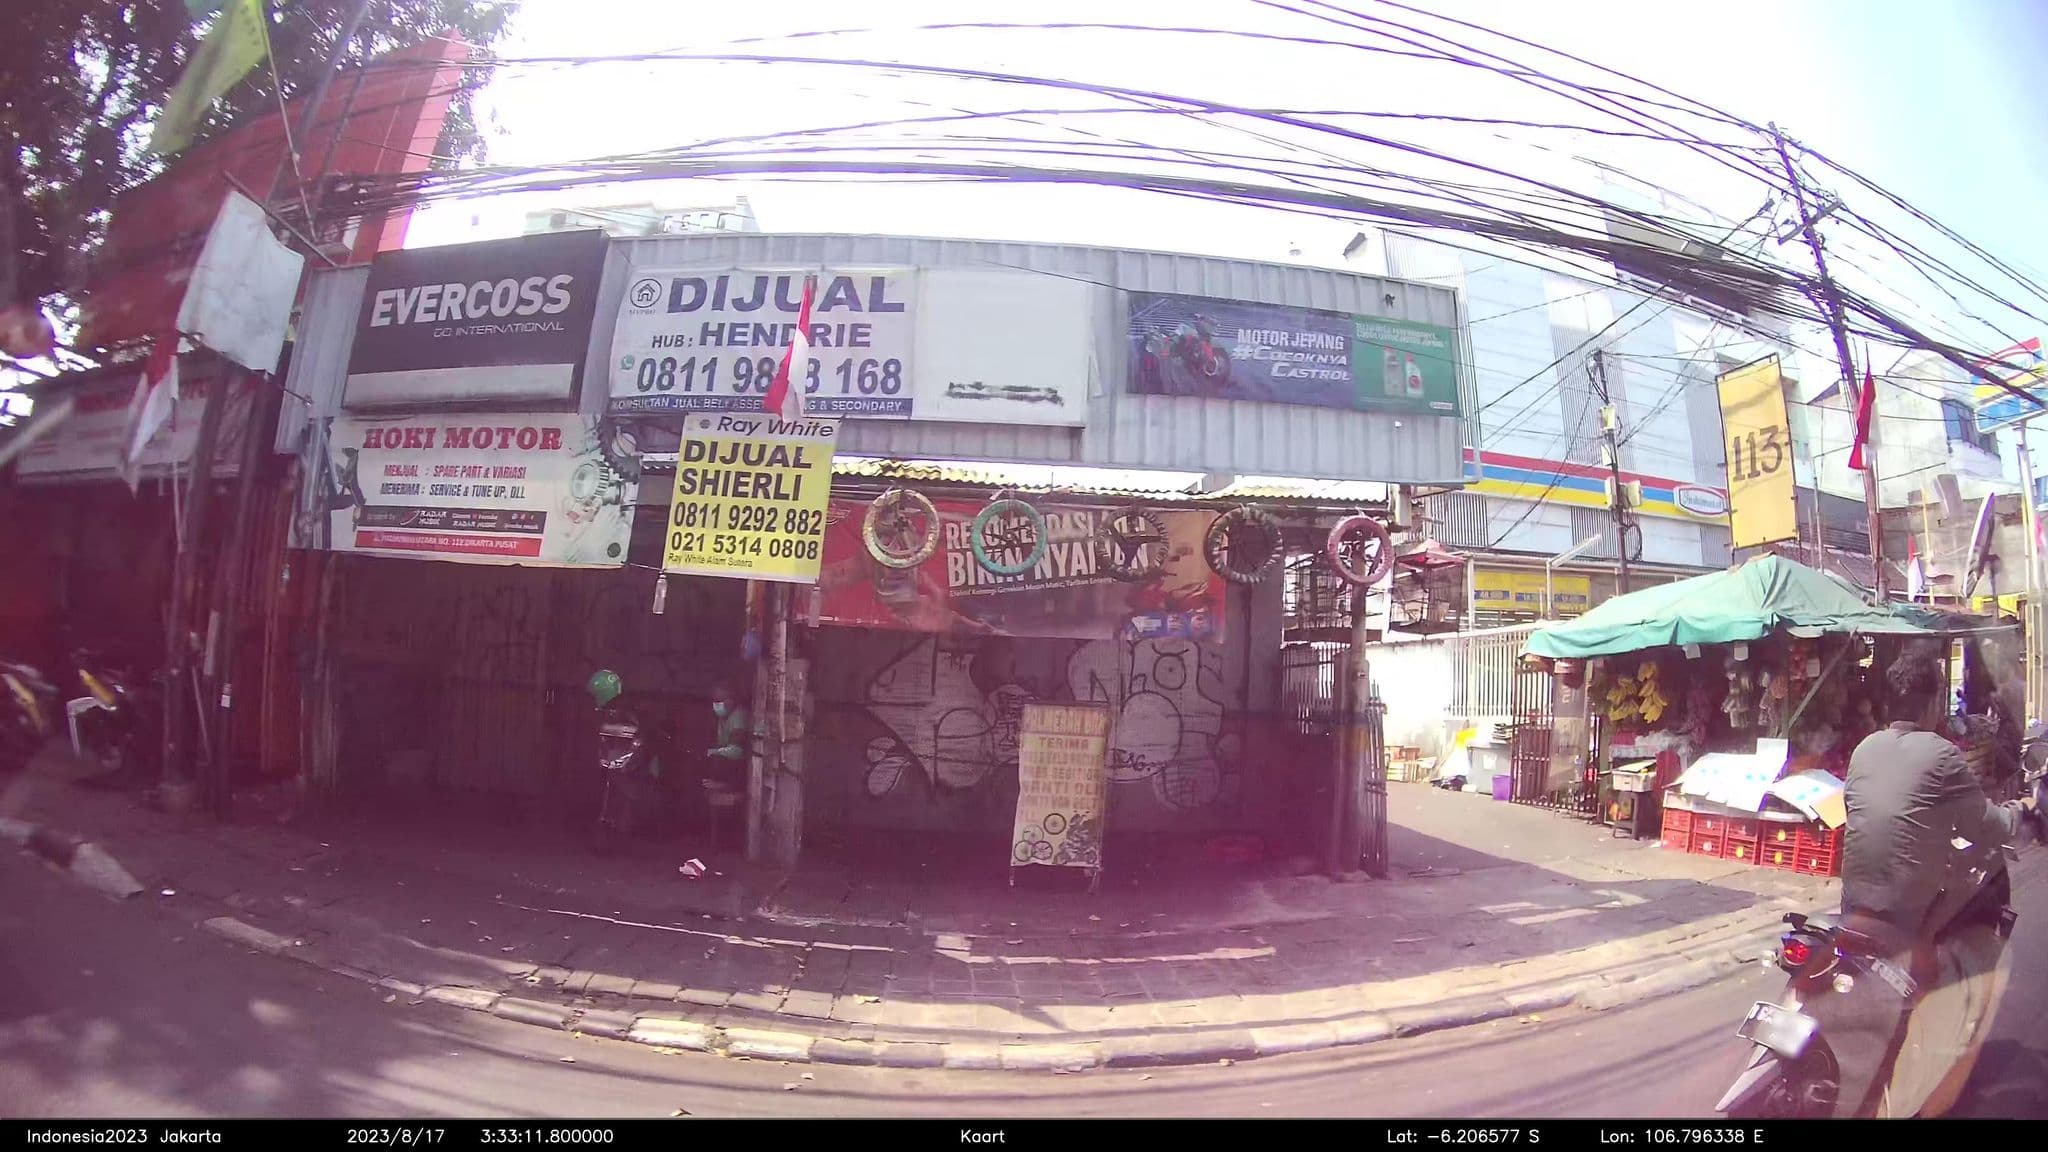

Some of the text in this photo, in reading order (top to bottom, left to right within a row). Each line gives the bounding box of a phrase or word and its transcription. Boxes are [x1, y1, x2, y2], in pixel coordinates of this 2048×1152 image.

[370, 274, 574, 328] EVERCOSS
[667, 275, 905, 314] DIJUAL
[456, 321, 564, 336] INTERNATIONAL
[1237, 328, 1289, 347] MOTOR
[1291, 332, 1345, 350] JEPANG
[636, 356, 719, 393] 0811
[836, 358, 902, 395] 168
[672, 398, 700, 409] JUAL
[832, 400, 902, 411] SECONDARY
[362, 427, 564, 450] HOKI MOTOR
[716, 416, 834, 438] Ray White
[683, 439, 812, 469] DIJUAL
[1730, 426, 1784, 483] 113
[433, 464, 458, 478] SPARE
[460, 466, 482, 478] PART
[492, 466, 526, 480] VARIASI
[679, 468, 803, 502] SHIERLI
[429, 484, 462, 496] SERVICE
[471, 485, 493, 498] TUNE
[510, 486, 526, 499] DLL
[674, 501, 722, 529] 0811
[728, 504, 778, 533] 9292
[784, 508, 823, 536] 882
[671, 531, 819, 560] 021 5314 0808
